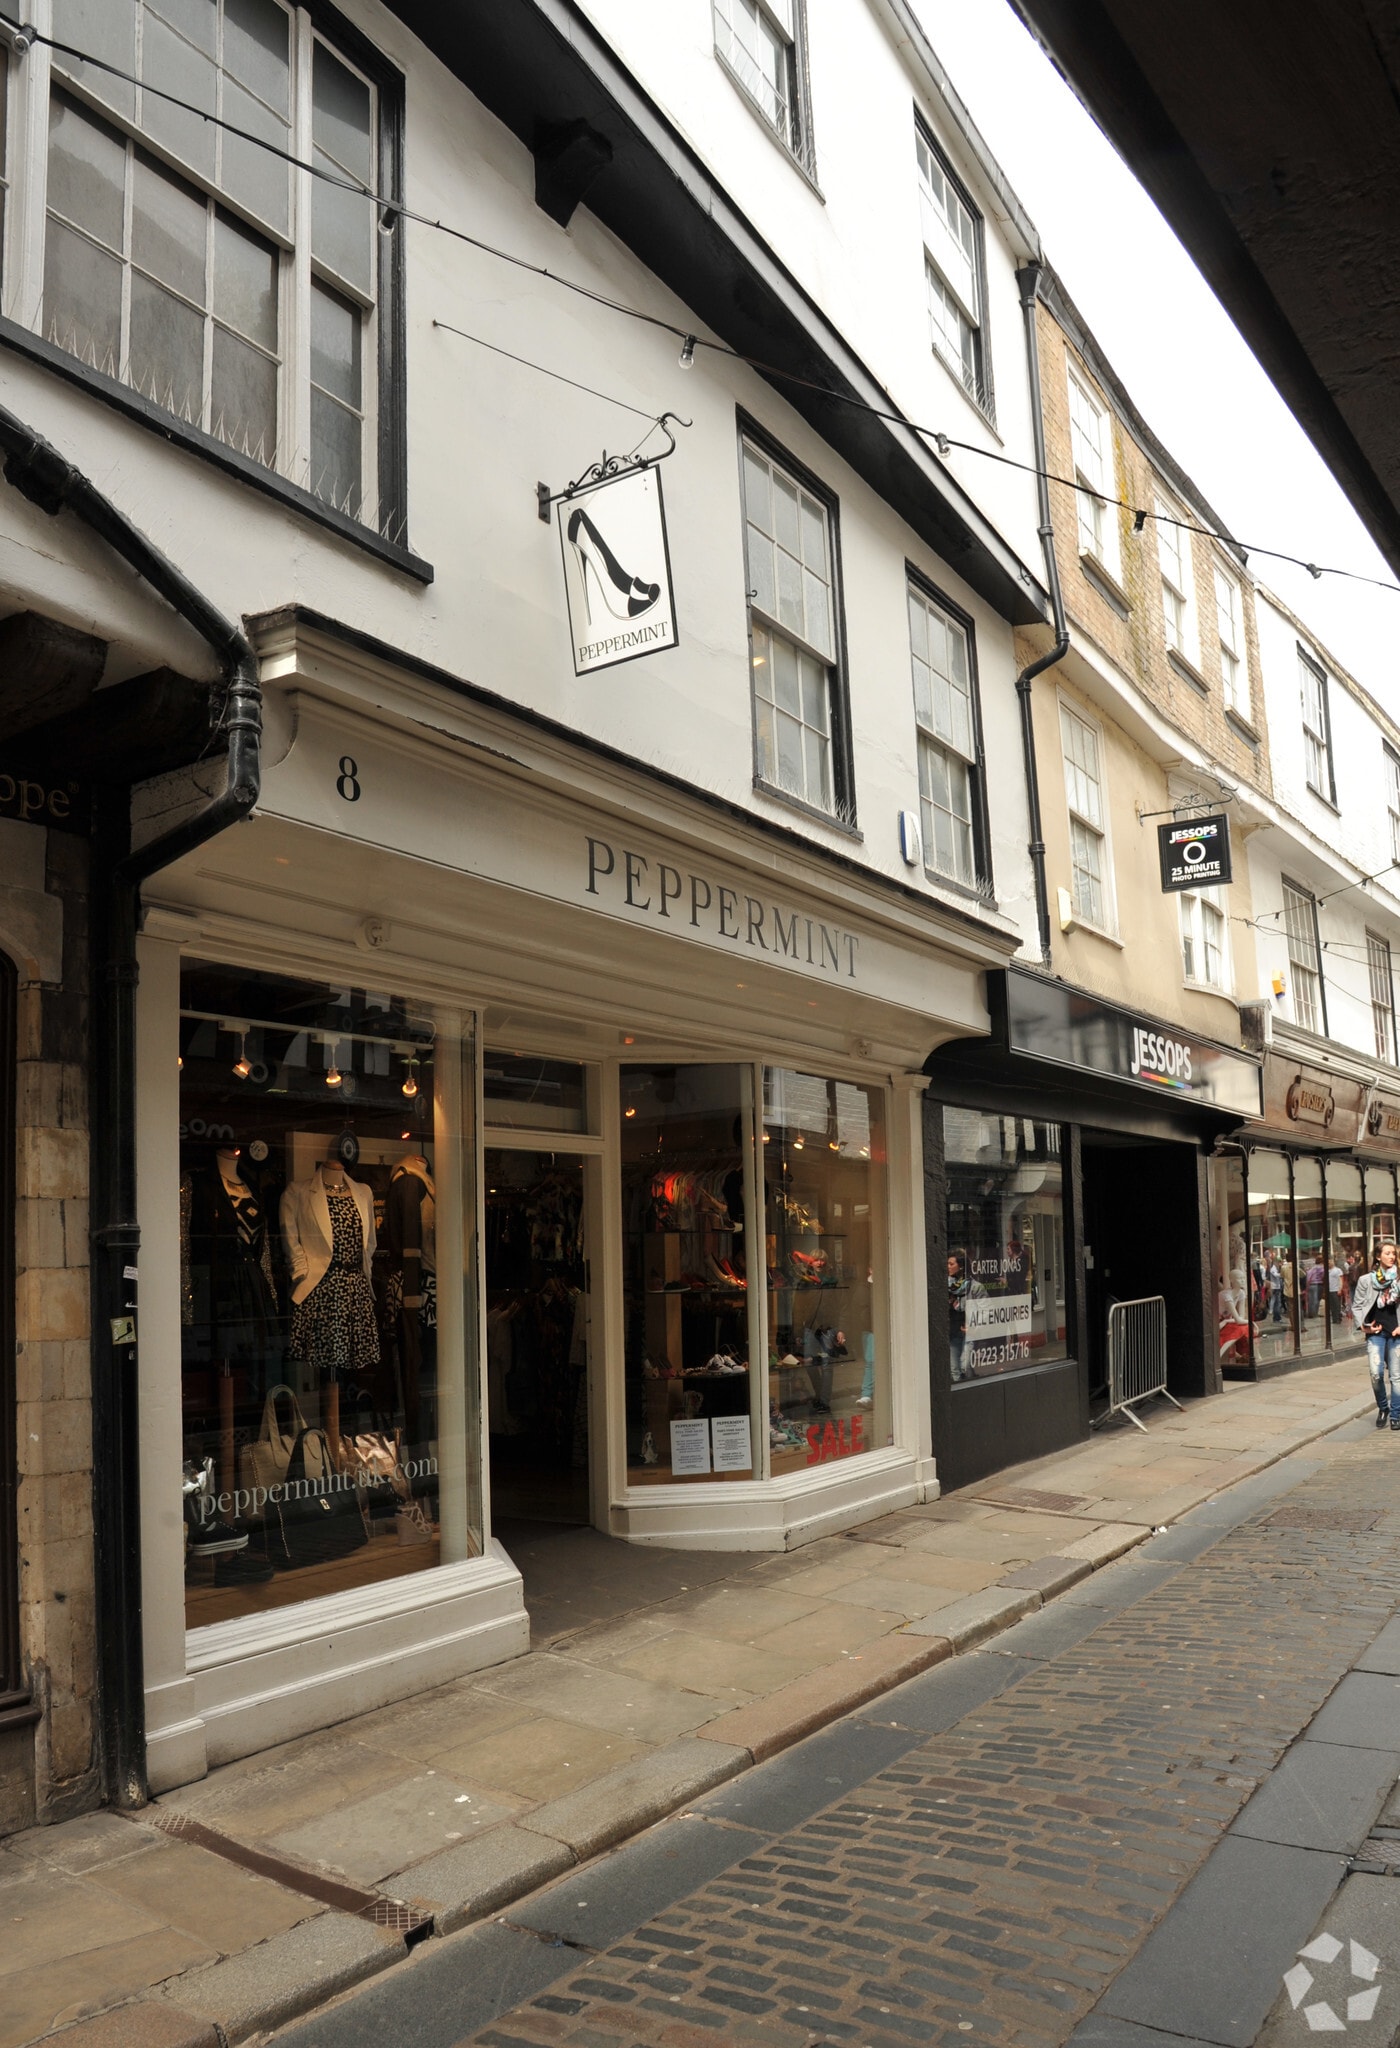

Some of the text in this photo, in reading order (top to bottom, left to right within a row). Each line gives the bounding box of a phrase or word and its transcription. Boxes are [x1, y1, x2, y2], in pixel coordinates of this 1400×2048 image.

[578, 621, 668, 662] PEPPERMINT
[336, 755, 361, 802] 8
[1169, 825, 1218, 844] JESSOPS
[1171, 861, 1220, 876] 25 MINUTE
[1172, 870, 1220, 882] PHOTO PRINTING
[584, 835, 860, 979] PEPPERMINT
[1130, 1026, 1193, 1081] JESSOPS
[971, 1258, 1021, 1276] CARTER JONAS
[970, 1305, 1029, 1327] ALL ENQUIRIES
[970, 1340, 1030, 1369] 01223 315716
[805, 1414, 865, 1466] SALE
[198, 1456, 440, 1525] peppermint.uk.com
